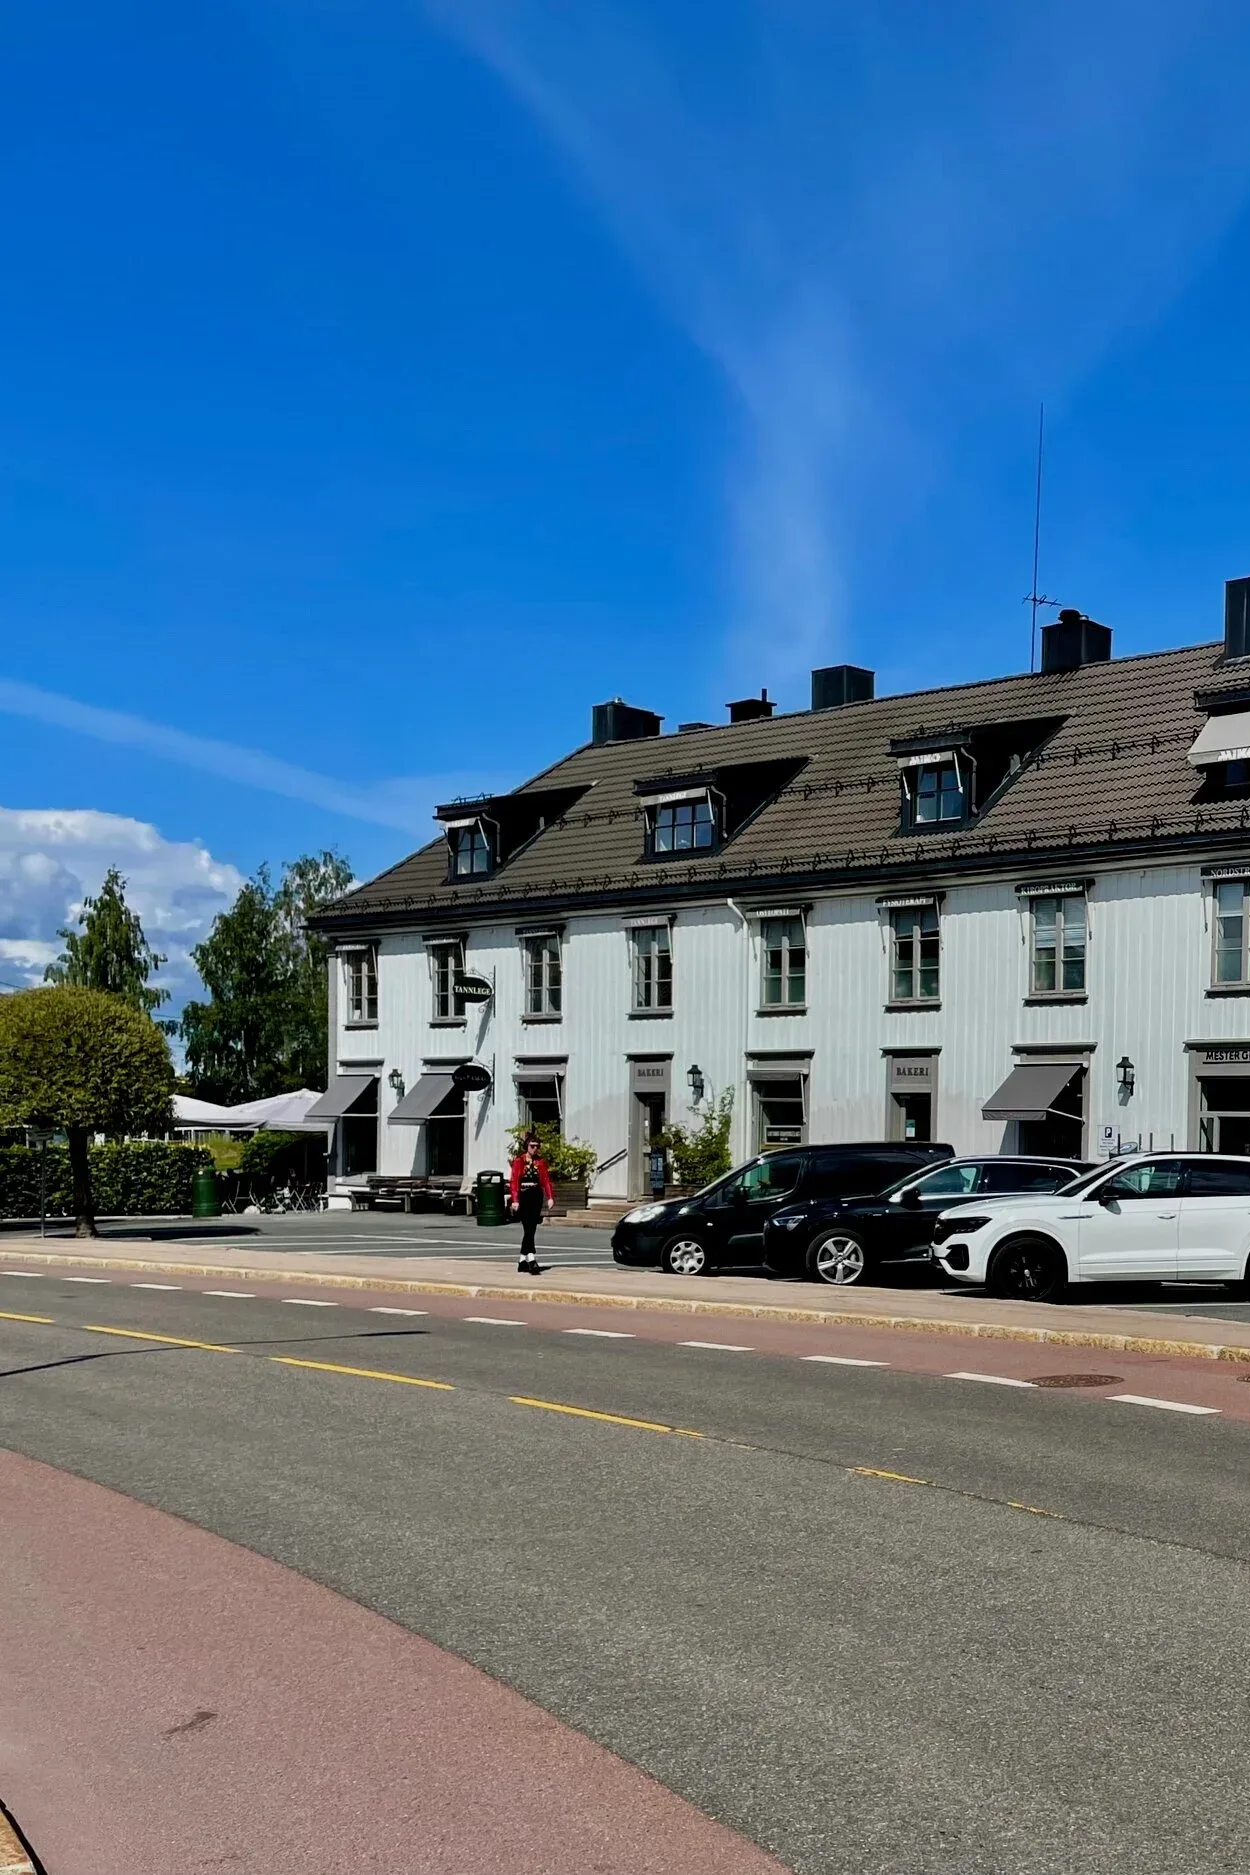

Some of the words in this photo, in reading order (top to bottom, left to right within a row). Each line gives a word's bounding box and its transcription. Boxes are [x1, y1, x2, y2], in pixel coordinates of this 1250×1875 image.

[1020, 882, 1076, 895] KIROPRAKTOR
[454, 984, 490, 996] TANNLEGE
[1205, 1051, 1239, 1061] MESTER
[637, 1068, 664, 1077] BAKERI
[896, 1067, 929, 1076] BAKERI
